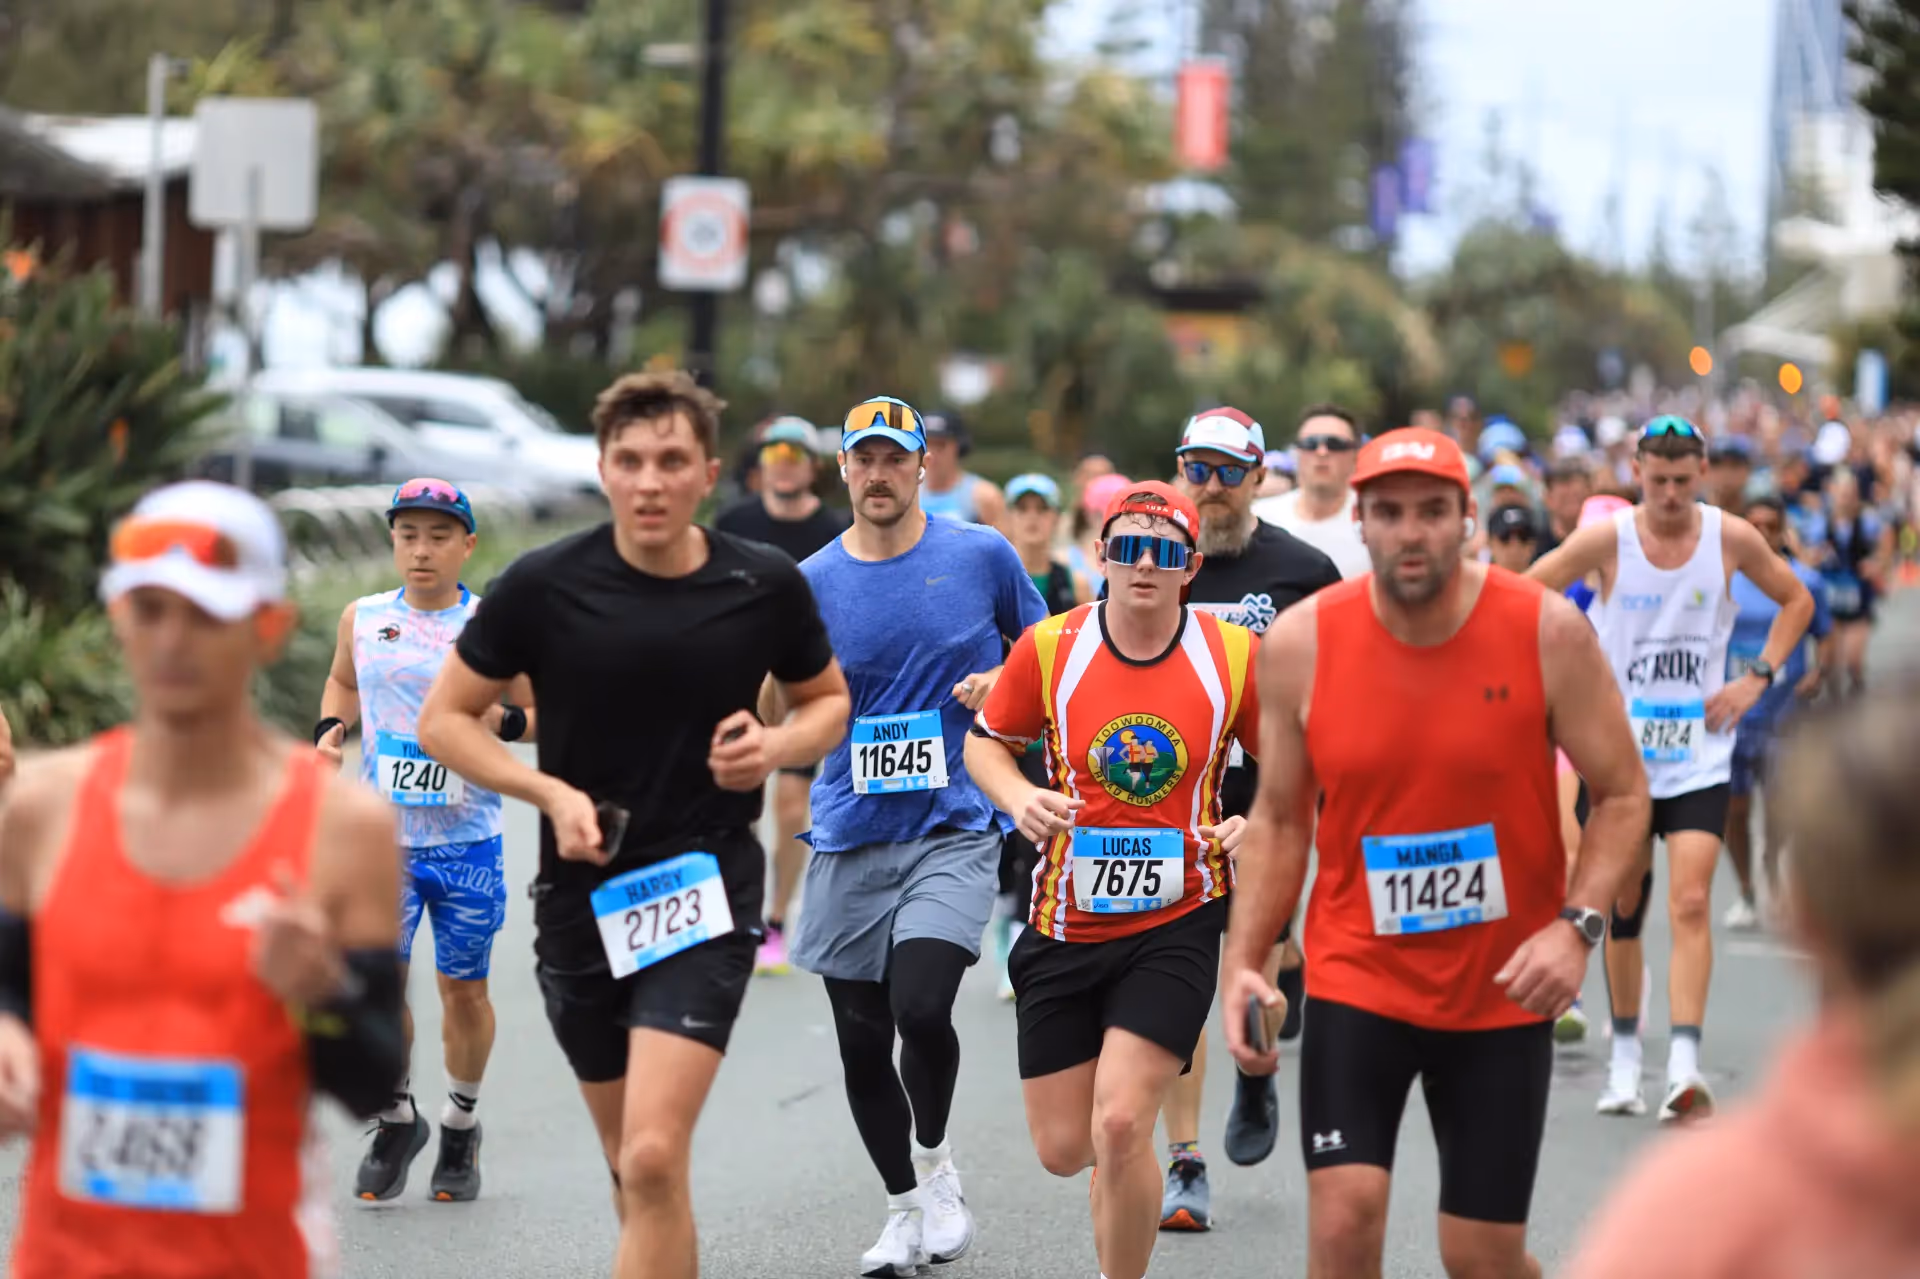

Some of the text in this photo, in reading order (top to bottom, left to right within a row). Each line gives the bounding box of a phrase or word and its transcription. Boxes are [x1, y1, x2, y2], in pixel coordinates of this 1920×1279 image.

[873, 722, 909, 742] ANDY
[1095, 715, 1181, 747] TOOWOOMBA
[1642, 720, 1692, 748] 8124
[859, 740, 932, 778] 11645
[391, 760, 447, 792] 1240
[1093, 771, 1180, 805] RAD RUNNERS
[1102, 837, 1152, 857] LUCAS
[1396, 841, 1465, 867] MANGA
[623, 868, 683, 905] HARRY
[1090, 859, 1164, 897] 7675
[1384, 861, 1486, 914] 11424
[624, 888, 702, 952] 2723
